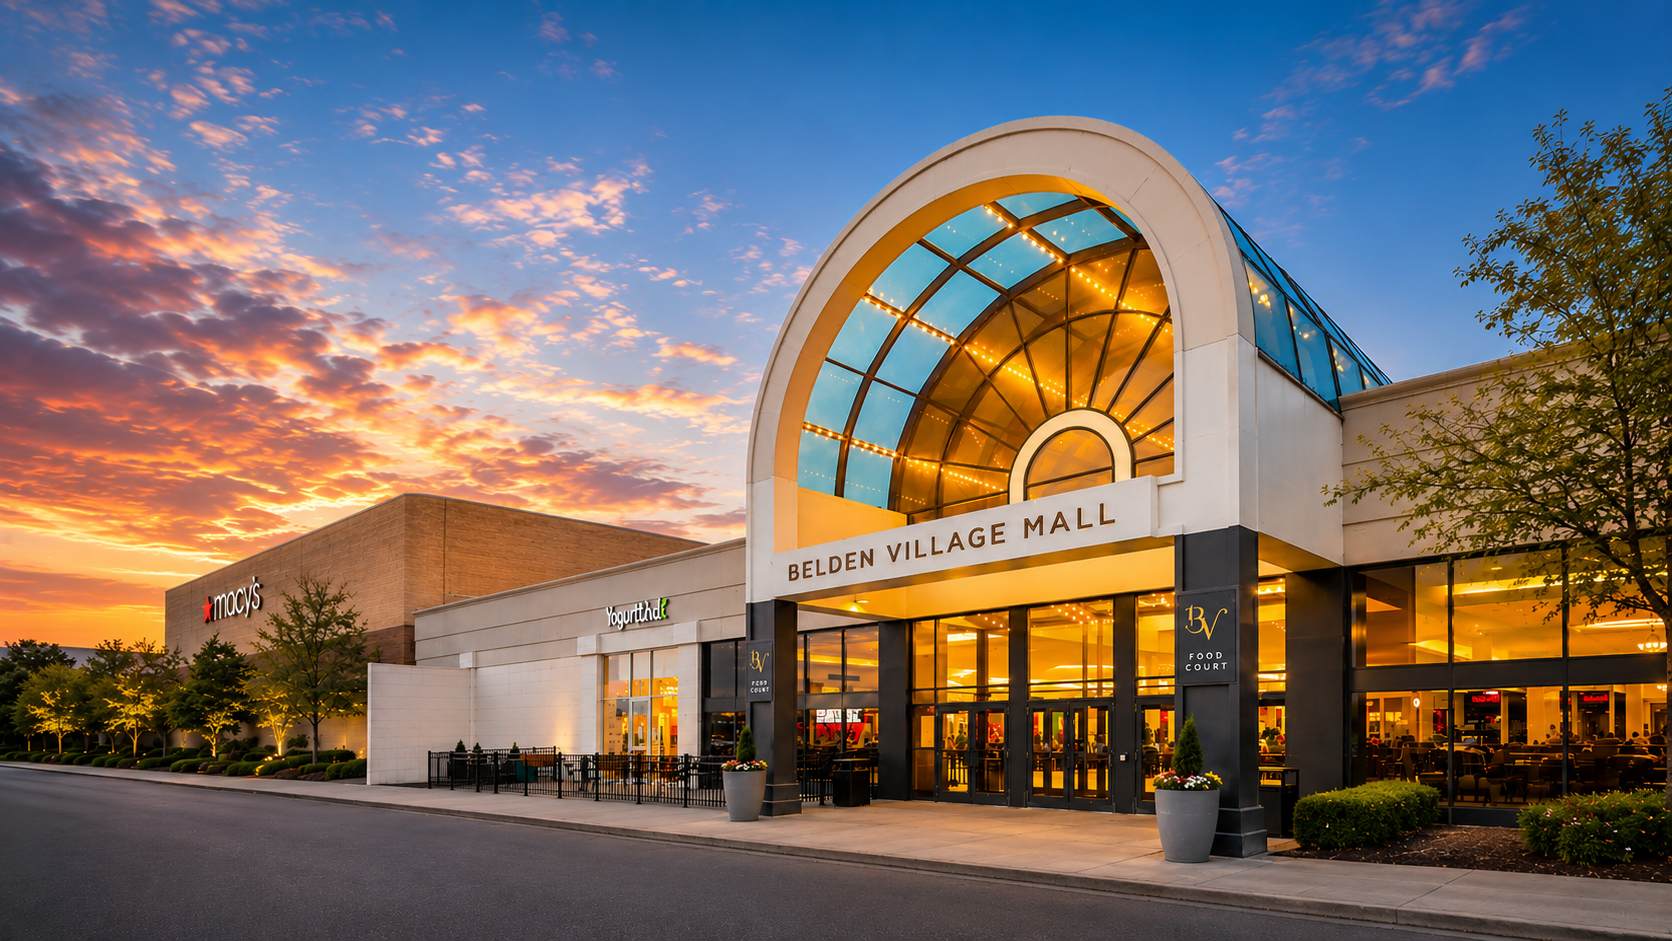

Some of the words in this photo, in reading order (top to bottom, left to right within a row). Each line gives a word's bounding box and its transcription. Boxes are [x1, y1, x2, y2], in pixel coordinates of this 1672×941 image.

[788, 548, 875, 582] BELDEN
[886, 522, 1006, 563] VILLAGE
[1023, 502, 1116, 539] MALL
[213, 576, 261, 620] macy's
[1185, 604, 1228, 640] BV
[1185, 661, 1228, 671] COURT
[1189, 651, 1223, 660] FOOD
